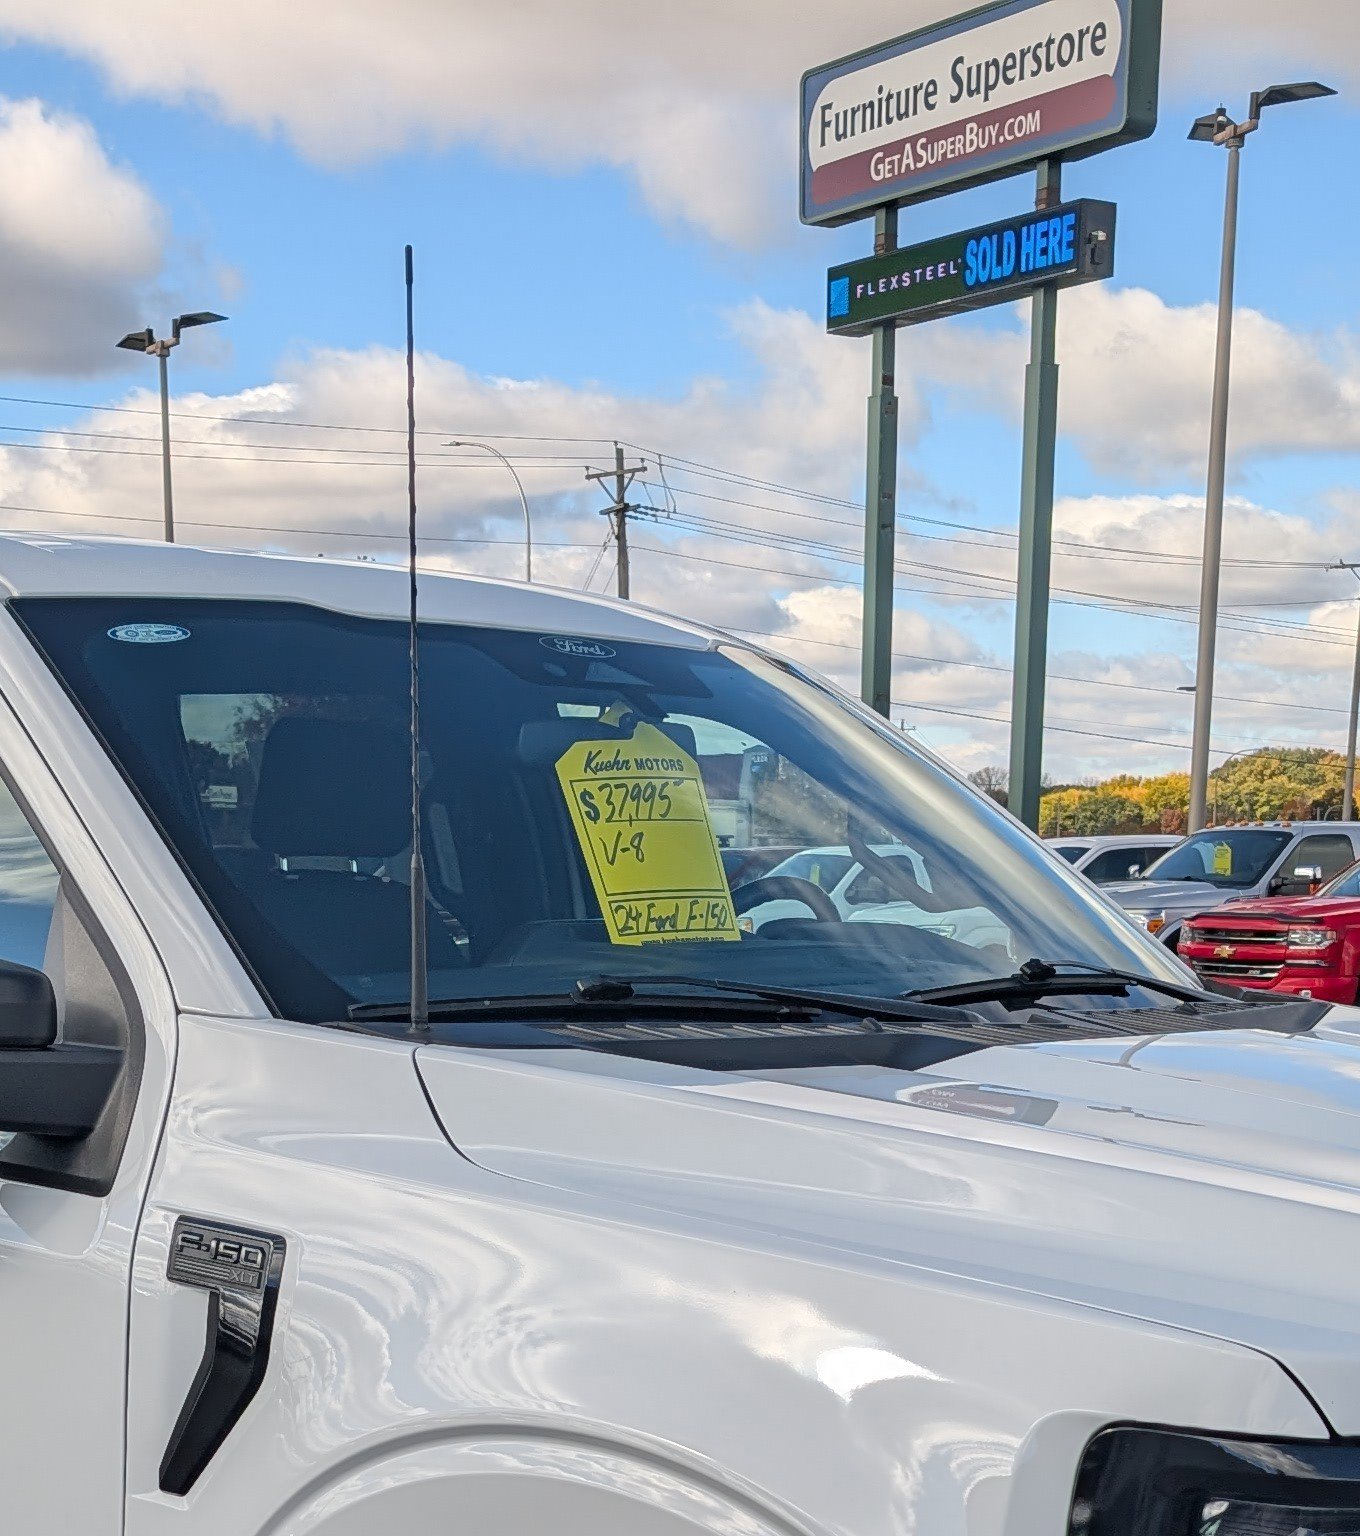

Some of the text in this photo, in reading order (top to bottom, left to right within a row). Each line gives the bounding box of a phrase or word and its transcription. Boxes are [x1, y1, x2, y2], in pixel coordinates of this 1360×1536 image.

[819, 20, 1107, 148] Furniture Superstore
[856, 213, 1076, 299] FLEXSTEEL SOLD HERE
[553, 638, 605, 656] Ford
[583, 749, 684, 775] Kuehn MOTORS
[599, 830, 645, 866] V-8
[645, 902, 679, 931] Ford
[177, 1230, 267, 1269] F-150
[229, 1269, 258, 1285] XLT
